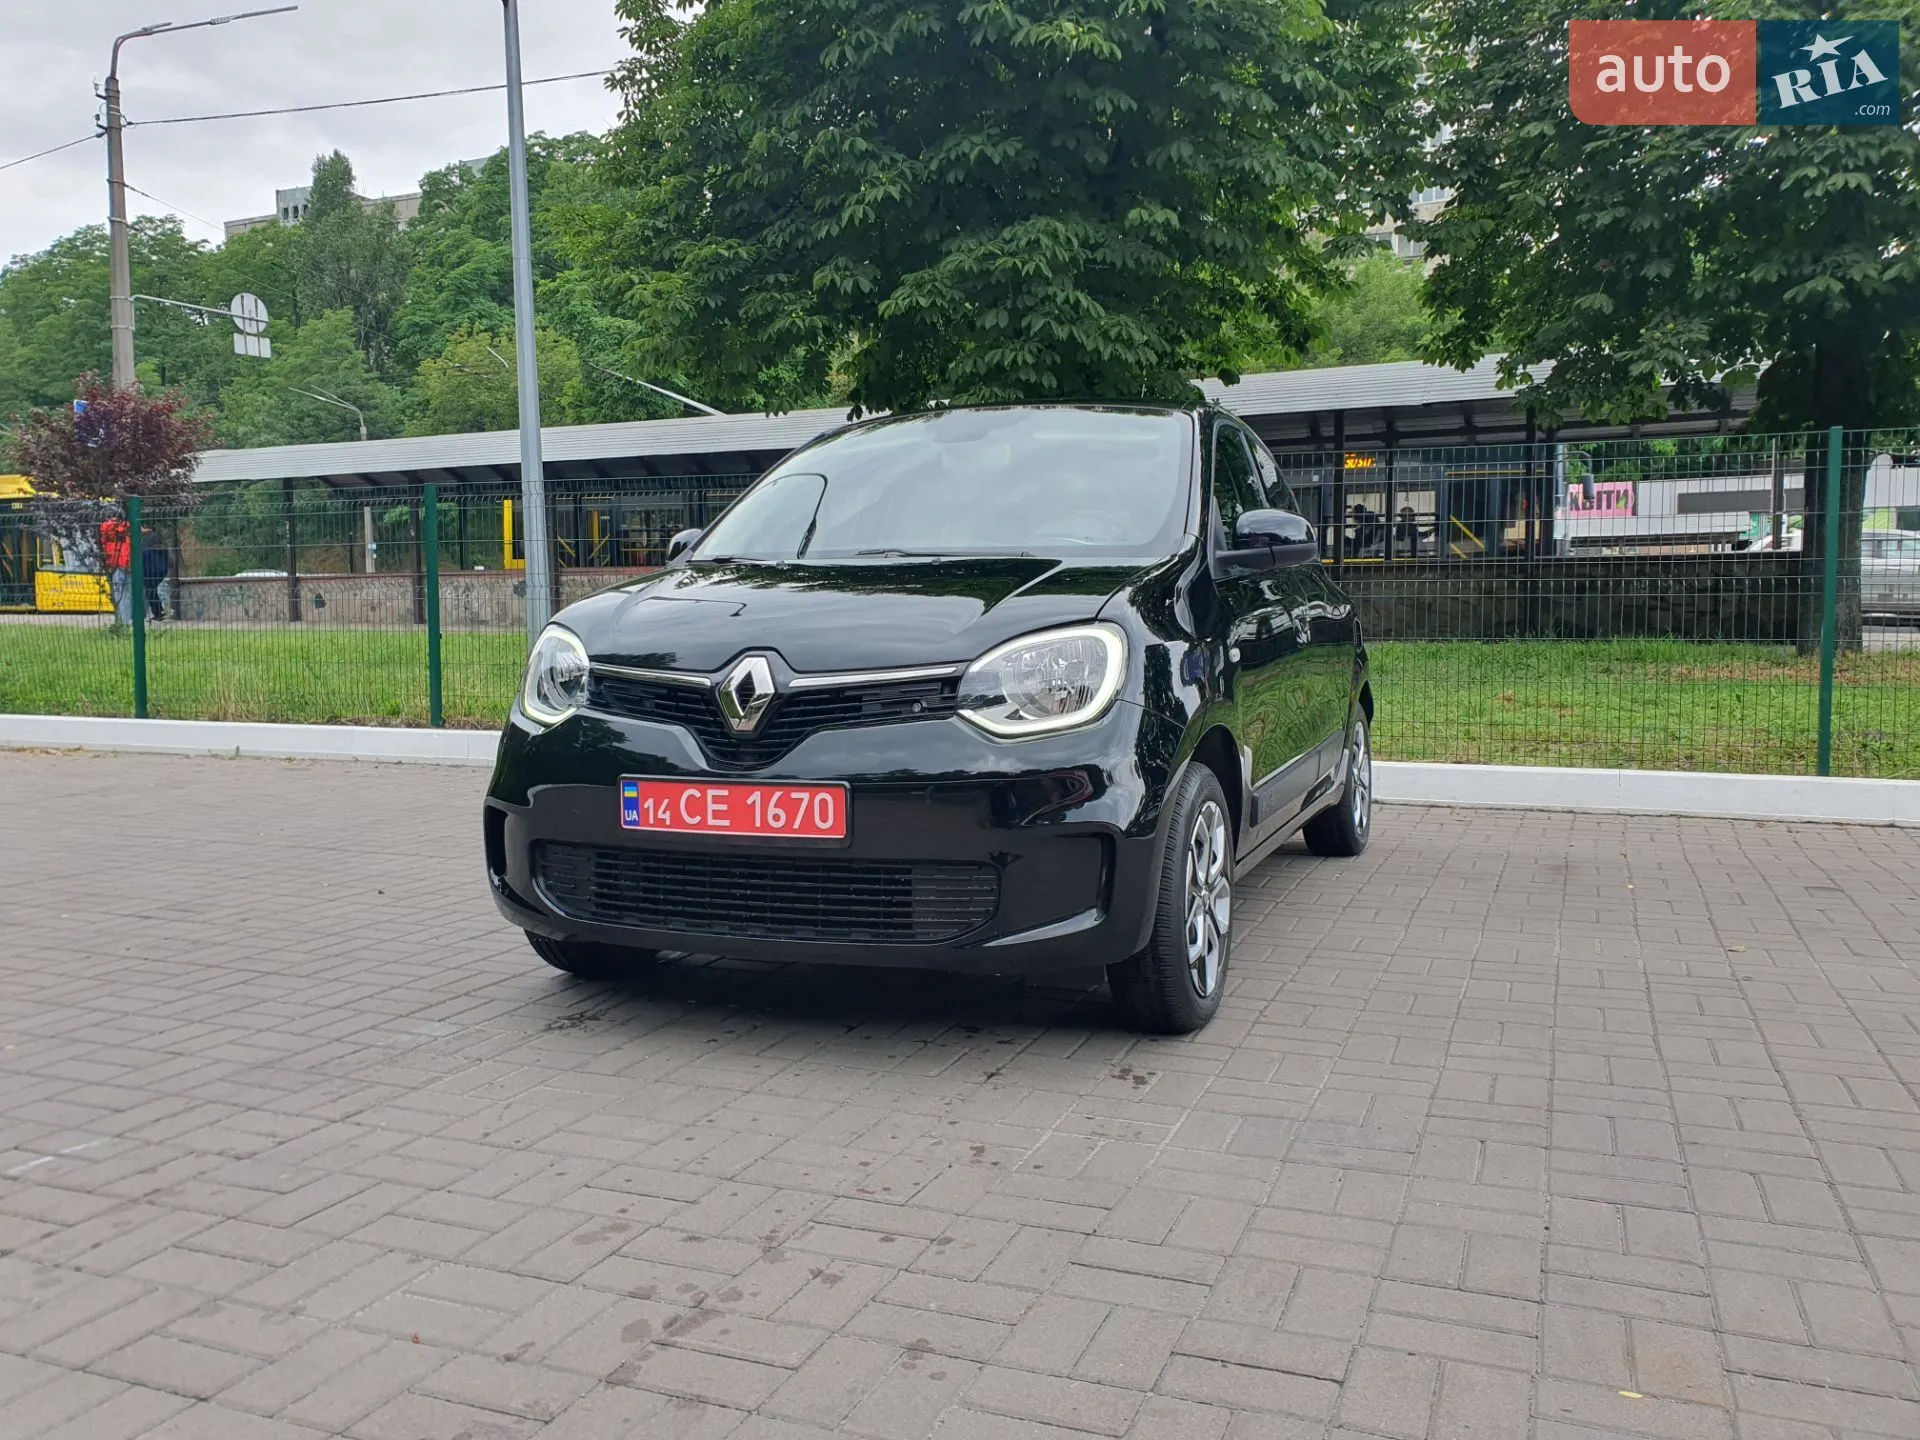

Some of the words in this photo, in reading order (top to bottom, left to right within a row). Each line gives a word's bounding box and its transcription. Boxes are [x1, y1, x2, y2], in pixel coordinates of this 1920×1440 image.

[625, 810, 639, 821] UA
[643, 797, 671, 826] 14
[679, 788, 730, 827] CE
[746, 790, 834, 830] 1670
